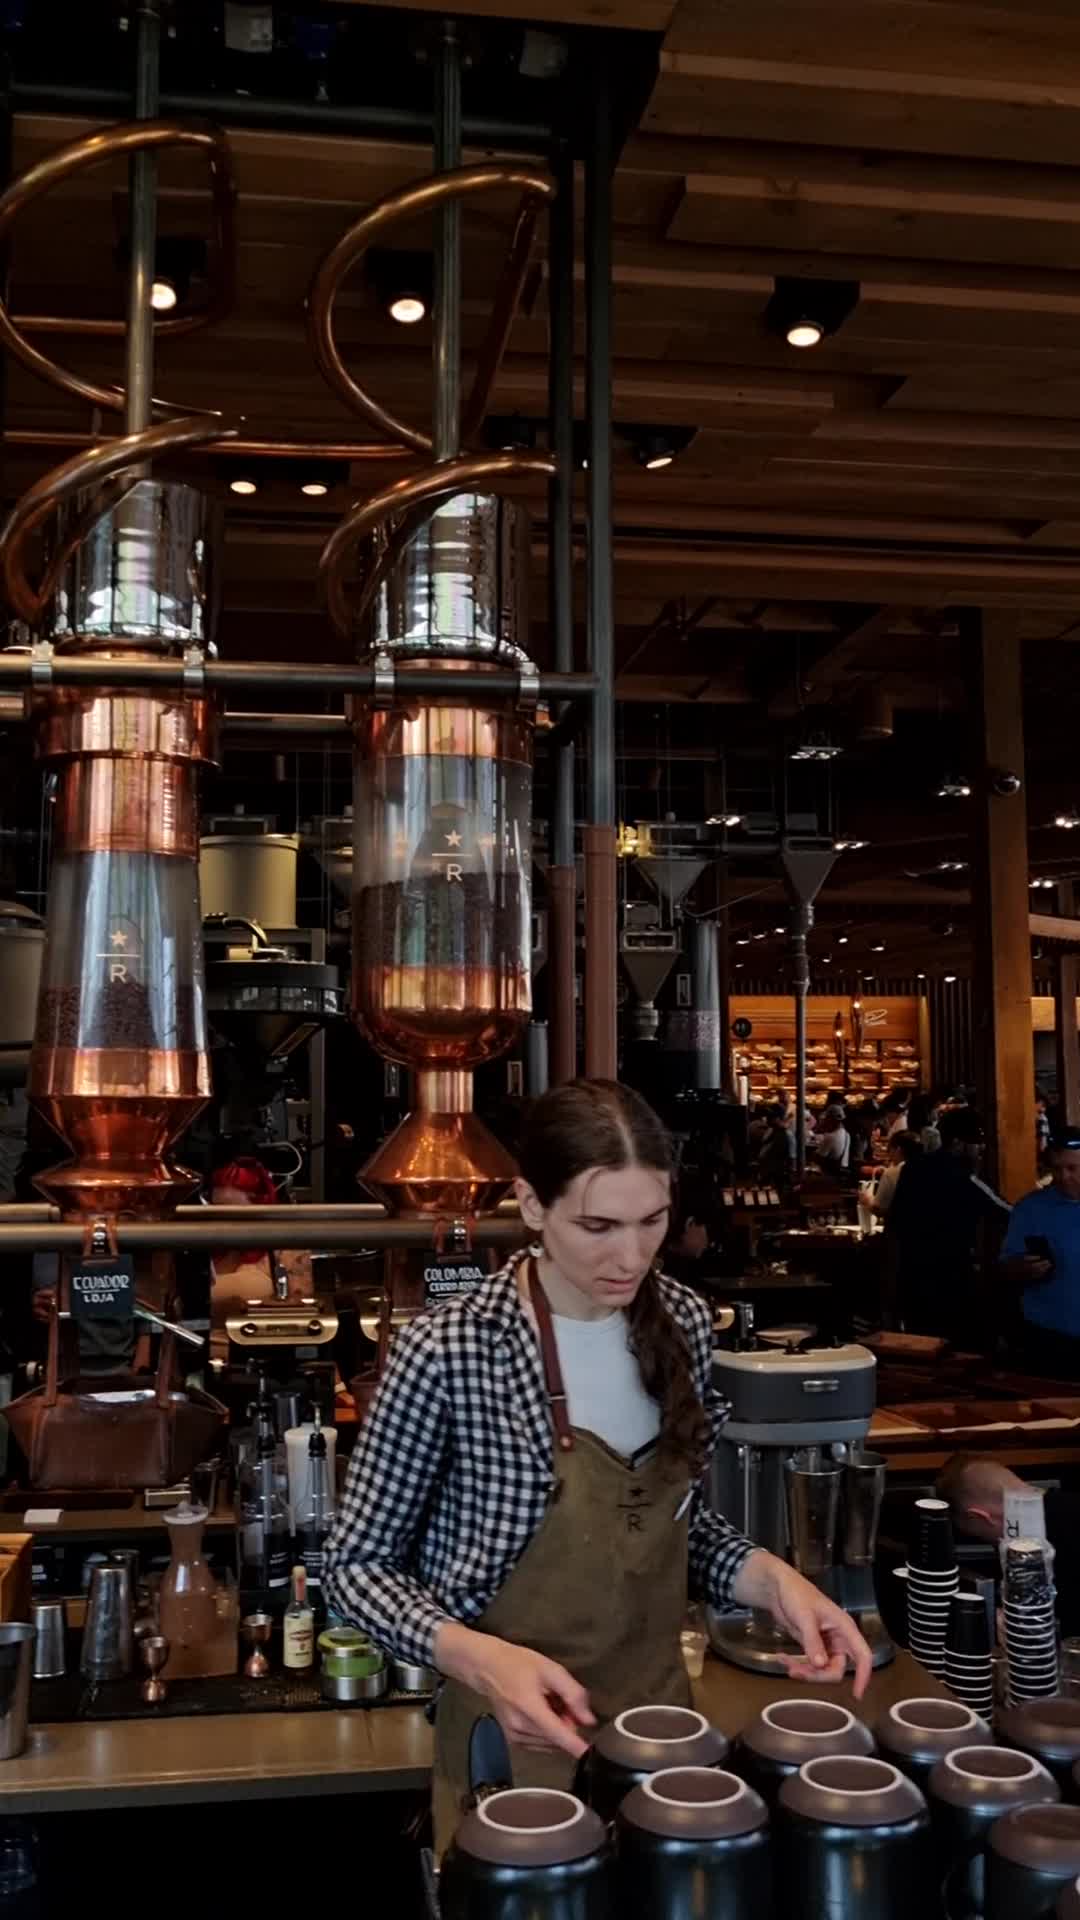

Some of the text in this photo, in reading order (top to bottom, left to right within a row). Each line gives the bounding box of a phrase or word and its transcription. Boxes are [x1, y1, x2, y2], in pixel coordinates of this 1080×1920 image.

[447, 863, 463, 882] R
[111, 964, 127, 983] R
[73, 1275, 130, 1290] ECUADOR
[83, 1293, 115, 1303] LOJA
[628, 1513, 643, 1532] R
